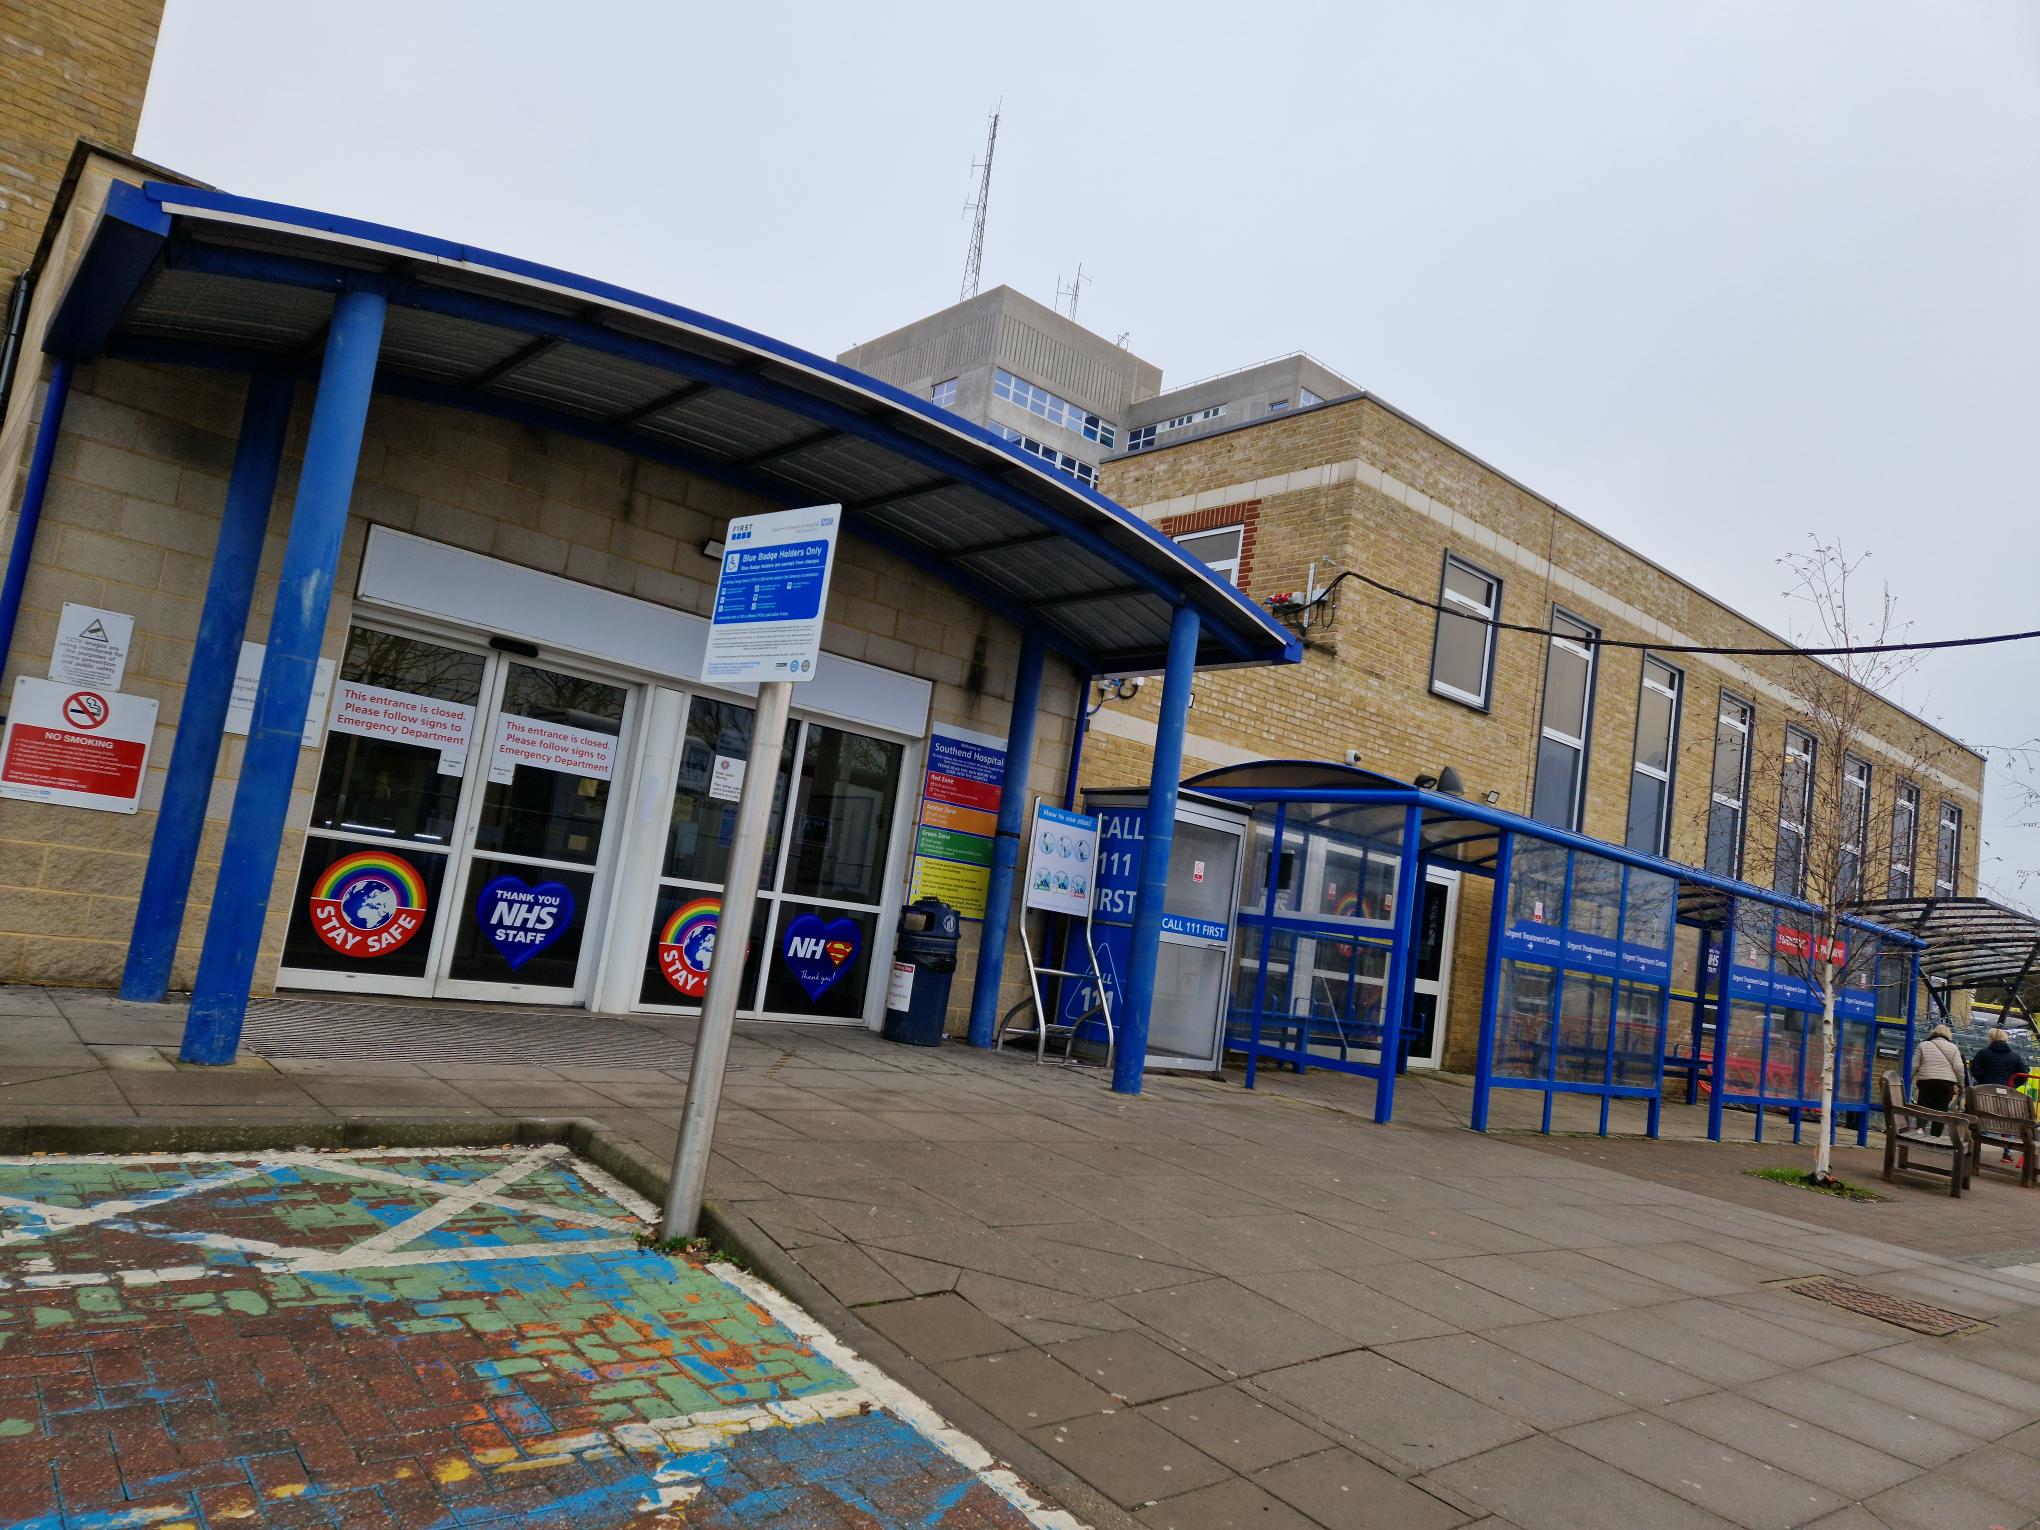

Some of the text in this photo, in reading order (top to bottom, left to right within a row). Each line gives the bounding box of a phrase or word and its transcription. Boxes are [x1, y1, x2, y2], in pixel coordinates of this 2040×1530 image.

[733, 523, 753, 532] FIRST
[743, 546, 822, 562] Blue Badge Holders Only
[80, 645, 112, 655] monitored
[85, 641, 107, 649] images
[82, 657, 116, 668] prevention
[344, 688, 466, 721] This entrance is closed.
[345, 702, 461, 732] Please follow signs to
[337, 714, 465, 746] Emergency Department
[506, 721, 610, 750] This entrance is closed.
[45, 731, 114, 749] NO SMOKING
[507, 733, 536, 746] Please
[539, 739, 568, 753] follow
[571, 747, 594, 760] signs
[499, 744, 608, 773] Emergency Department
[935, 743, 972, 758] Southend
[974, 752, 1004, 766] Hospital
[927, 804, 944, 812] Amber
[1044, 810, 1057, 818] How
[938, 832, 950, 840] Zone
[1099, 851, 1132, 876] 111
[495, 889, 561, 906] THANK YOU
[1094, 887, 1137, 915] IRST
[489, 901, 558, 930] NHS
[317, 905, 417, 953] STAY SAFE
[495, 928, 546, 945] STAFF
[1162, 918, 1225, 938] CALL 111 FIRST
[1505, 930, 1560, 947] Urgent Treatment Centre
[1567, 941, 1616, 958] Urgent Treatment Centre
[1623, 953, 1667, 968] Urgent Treatment Centre
[664, 949, 700, 991] STAY
[800, 969, 819, 981] Thank
